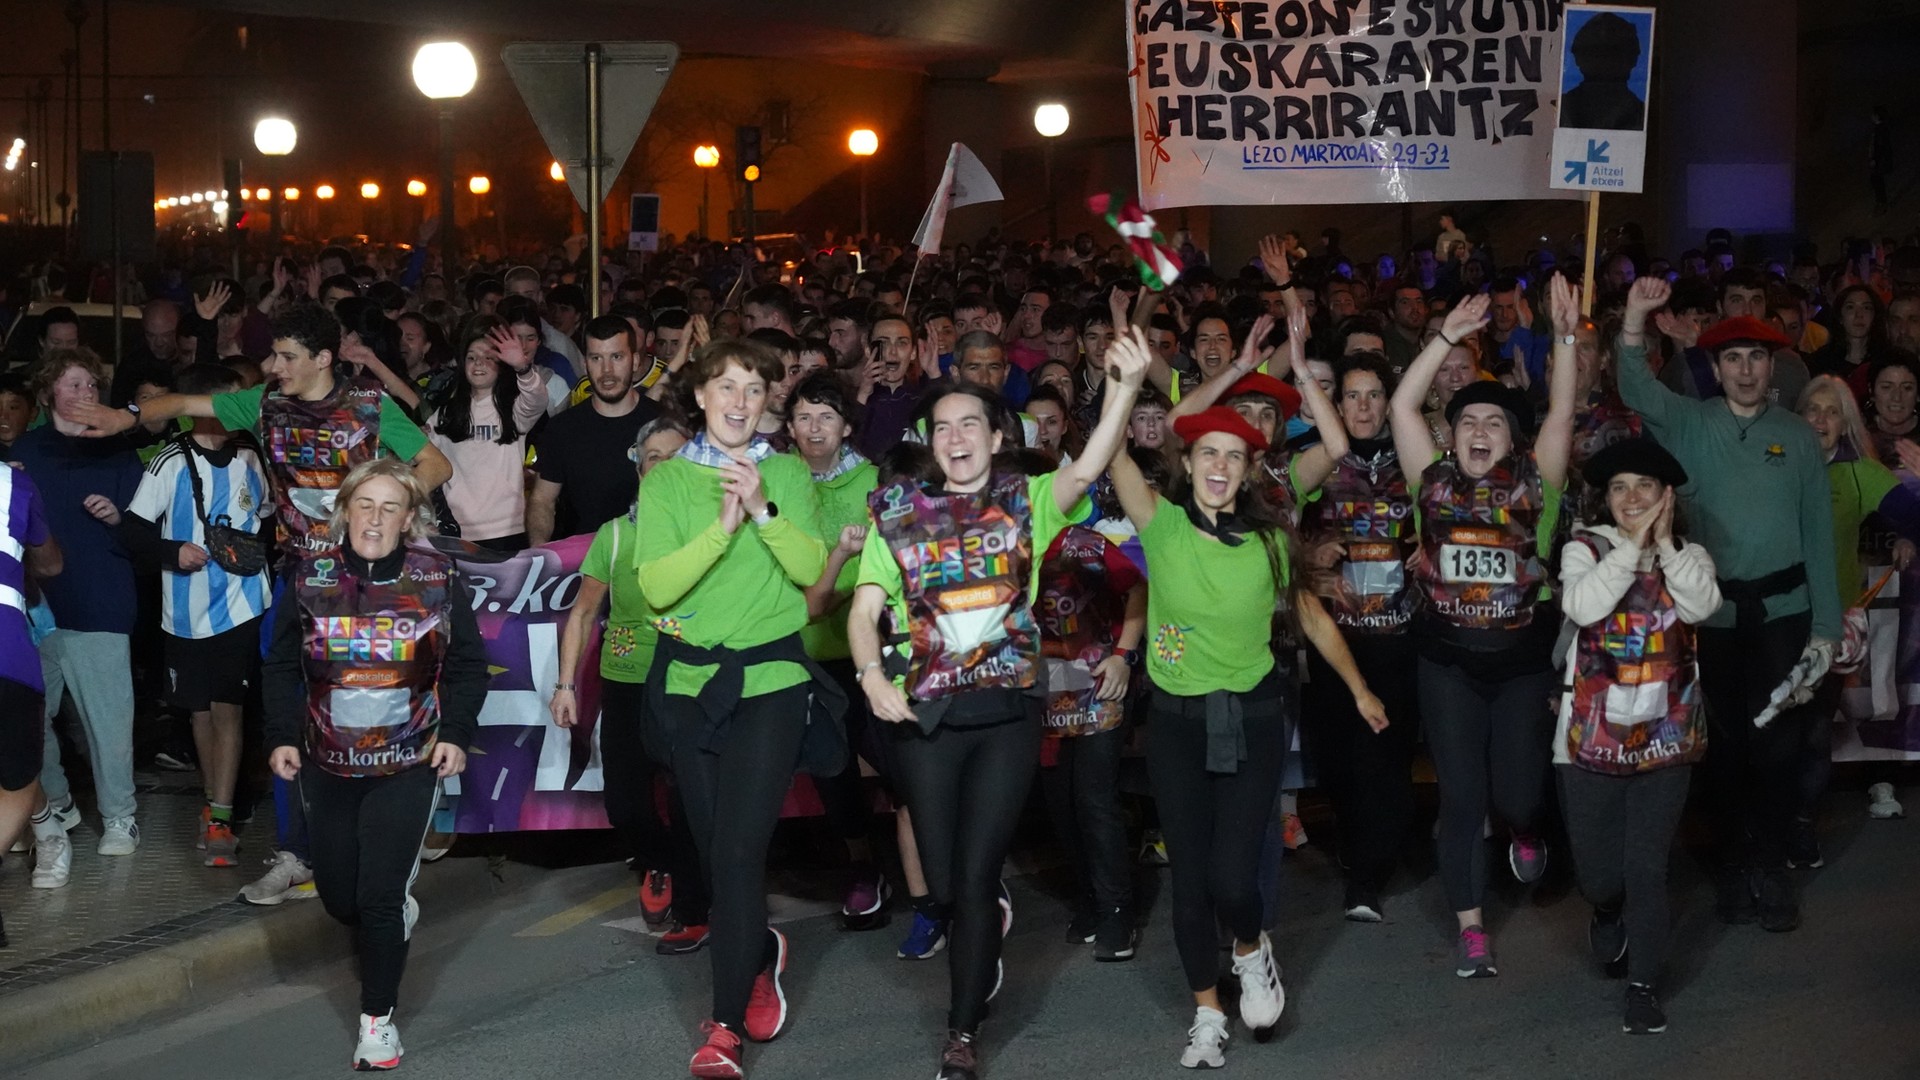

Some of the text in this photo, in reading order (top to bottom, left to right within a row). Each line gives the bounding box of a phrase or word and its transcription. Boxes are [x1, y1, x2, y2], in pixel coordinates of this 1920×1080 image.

[1147, 35, 1542, 92] EUSKARAREN
[1157, 88, 1540, 142] HERRIRANTZ
[1243, 145, 1287, 164] LEZO
[1393, 142, 1450, 164] 29-31
[1591, 176, 1625, 187] etxera
[1592, 165, 1624, 176] Aitzel
[1452, 549, 1507, 579] 1353
[424, 570, 448, 582] eitb
[346, 672, 395, 682] euskaltel
[327, 743, 417, 766] 23.korrika
